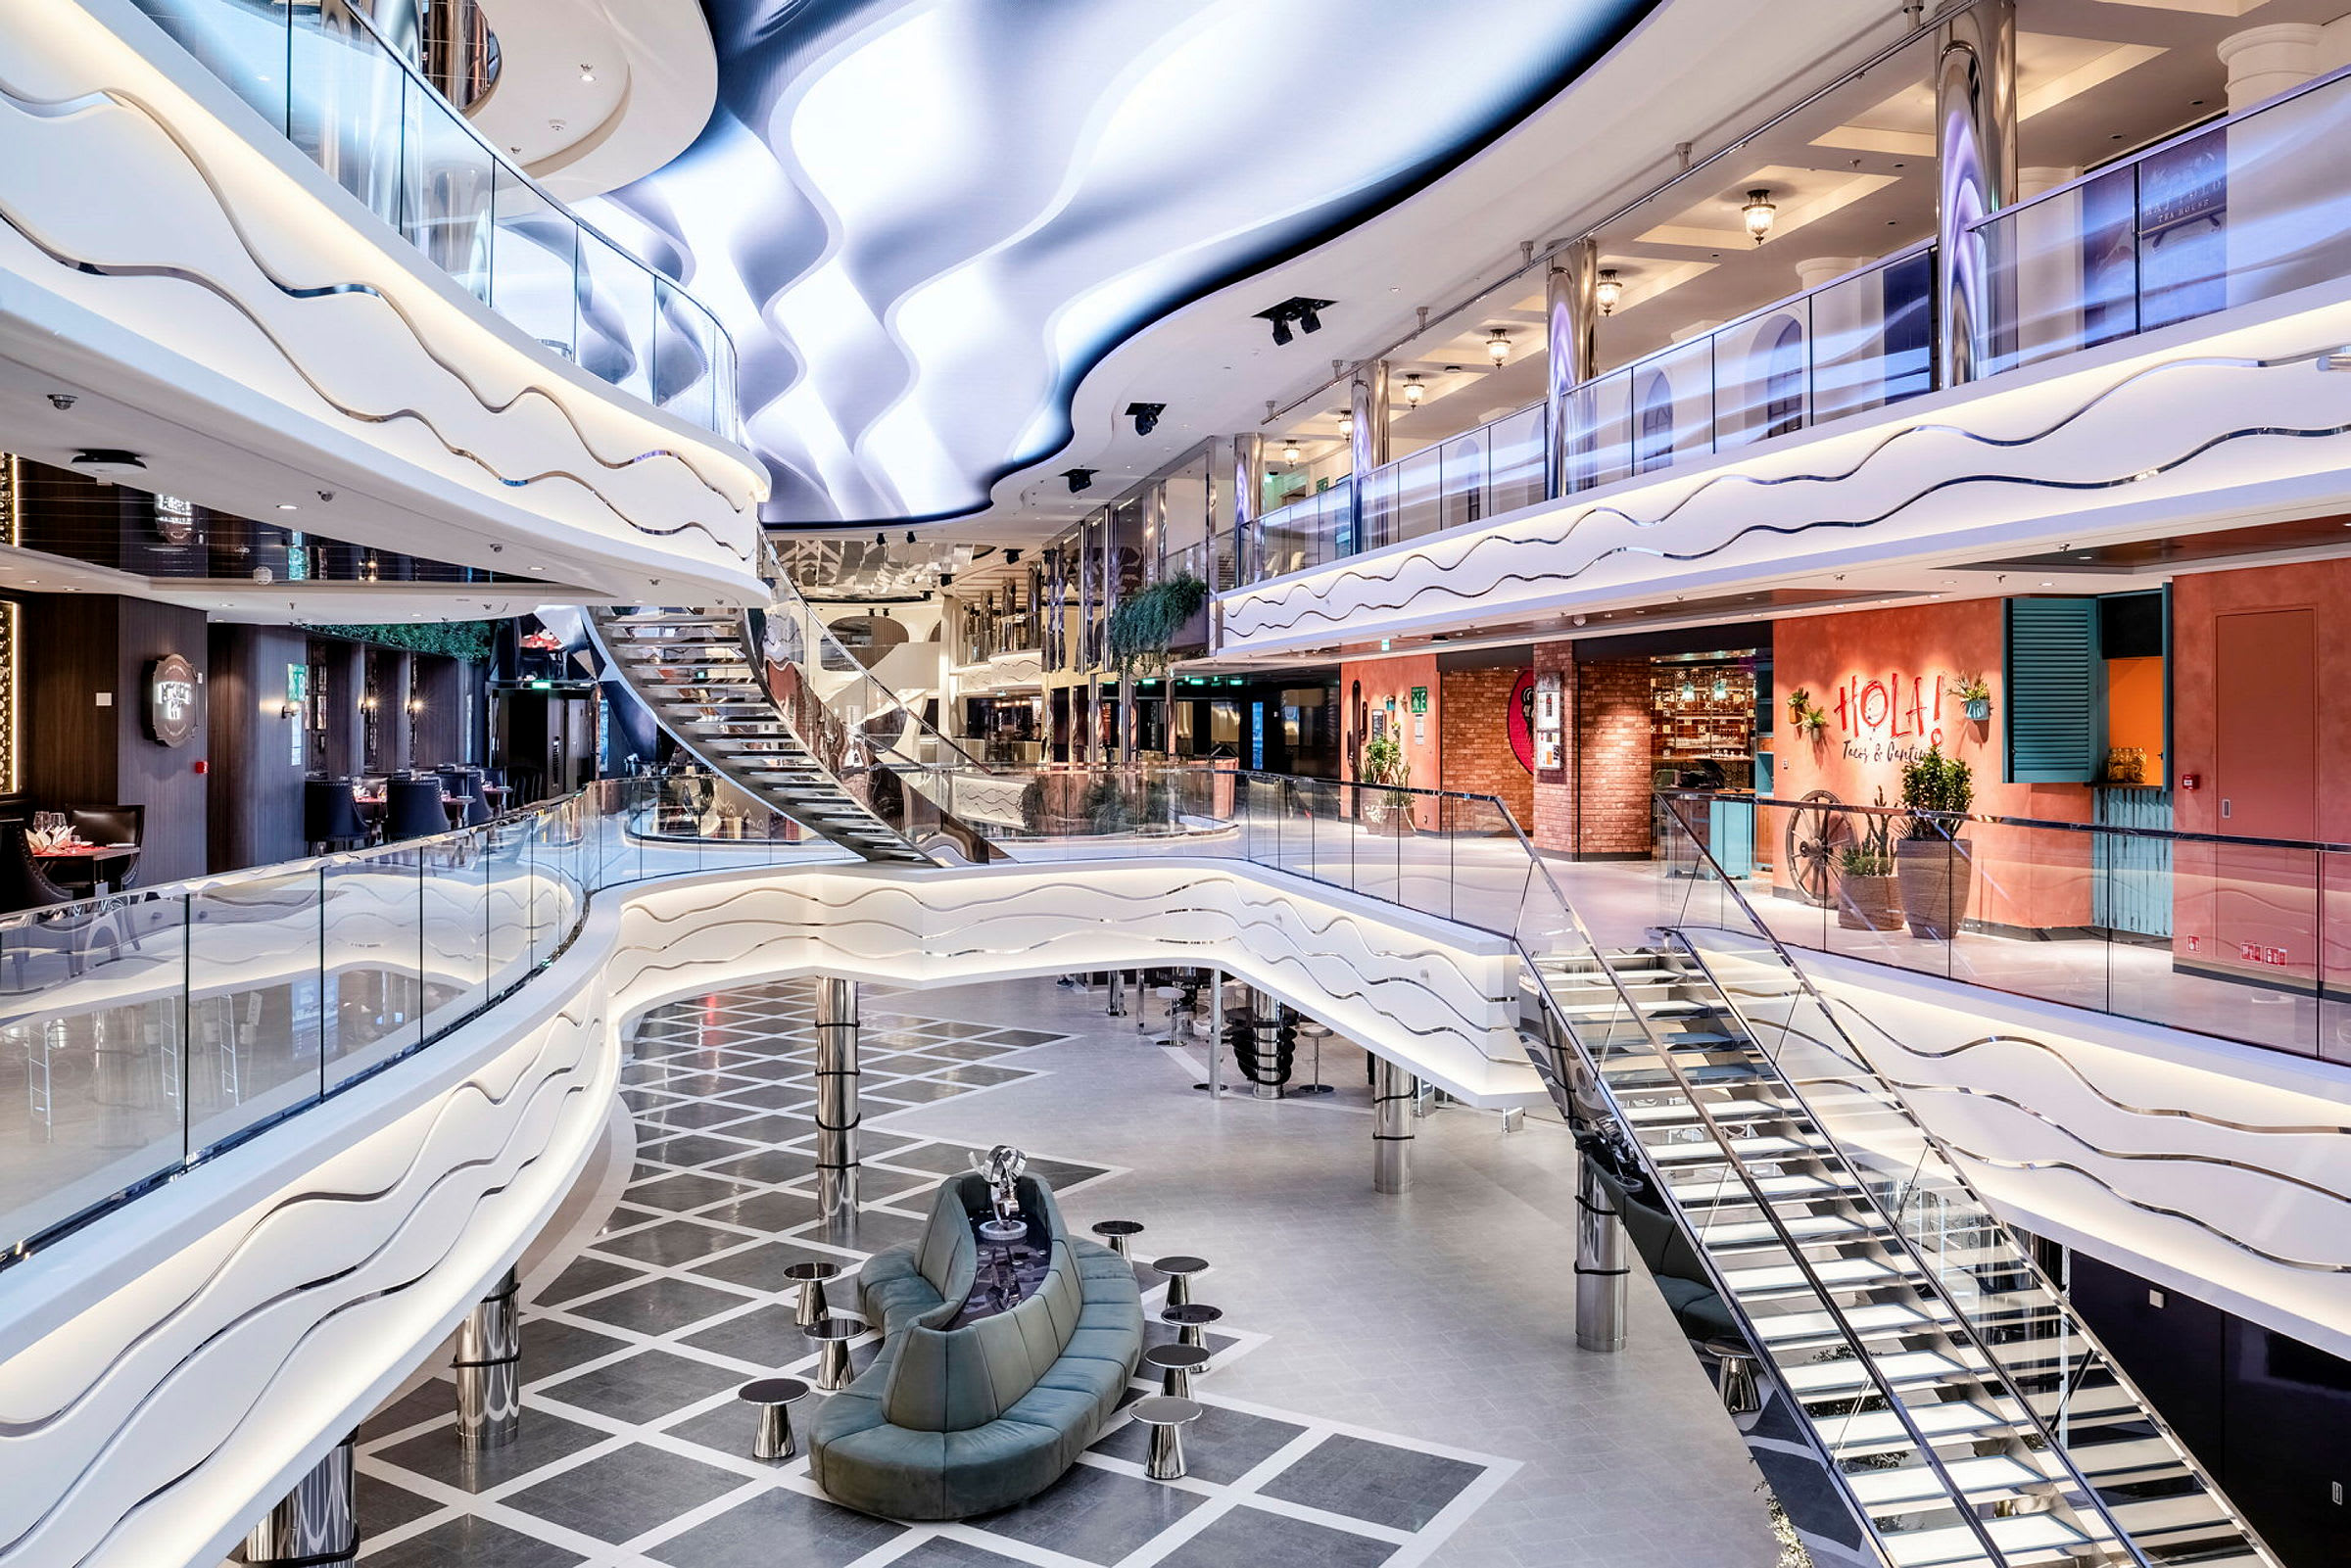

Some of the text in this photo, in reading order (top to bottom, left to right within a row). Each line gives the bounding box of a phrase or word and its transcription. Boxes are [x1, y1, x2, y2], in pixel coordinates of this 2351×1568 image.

[1834, 673, 1943, 746] HOLA!
[1843, 739, 1868, 763] Tacos
[1873, 742, 1883, 762] &
